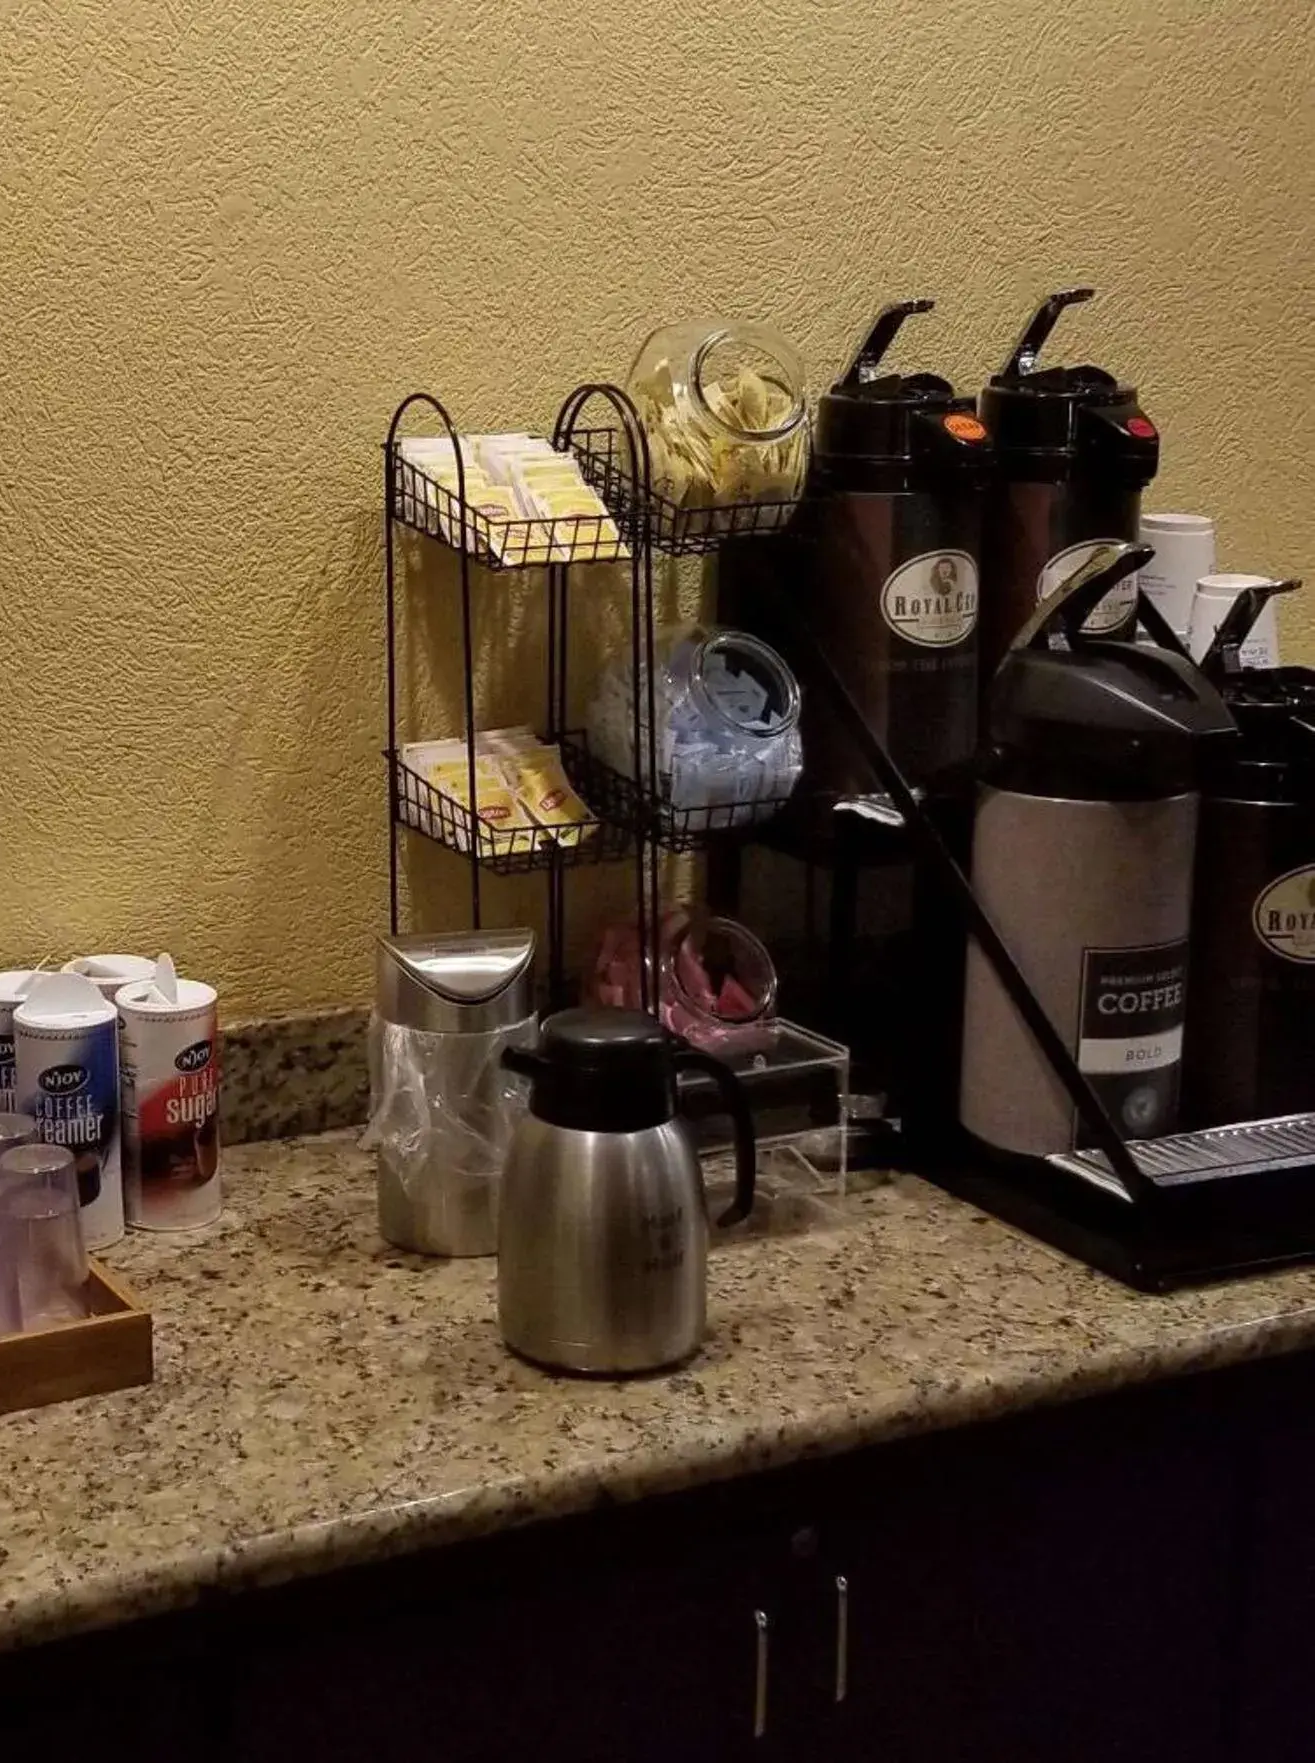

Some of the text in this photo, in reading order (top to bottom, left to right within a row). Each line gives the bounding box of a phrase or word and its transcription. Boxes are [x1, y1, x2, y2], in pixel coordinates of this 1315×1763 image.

[1097, 982, 1183, 1015] COFFEE
[35, 1094, 94, 1119] COFFEE
[166, 1086, 217, 1128] sugar
